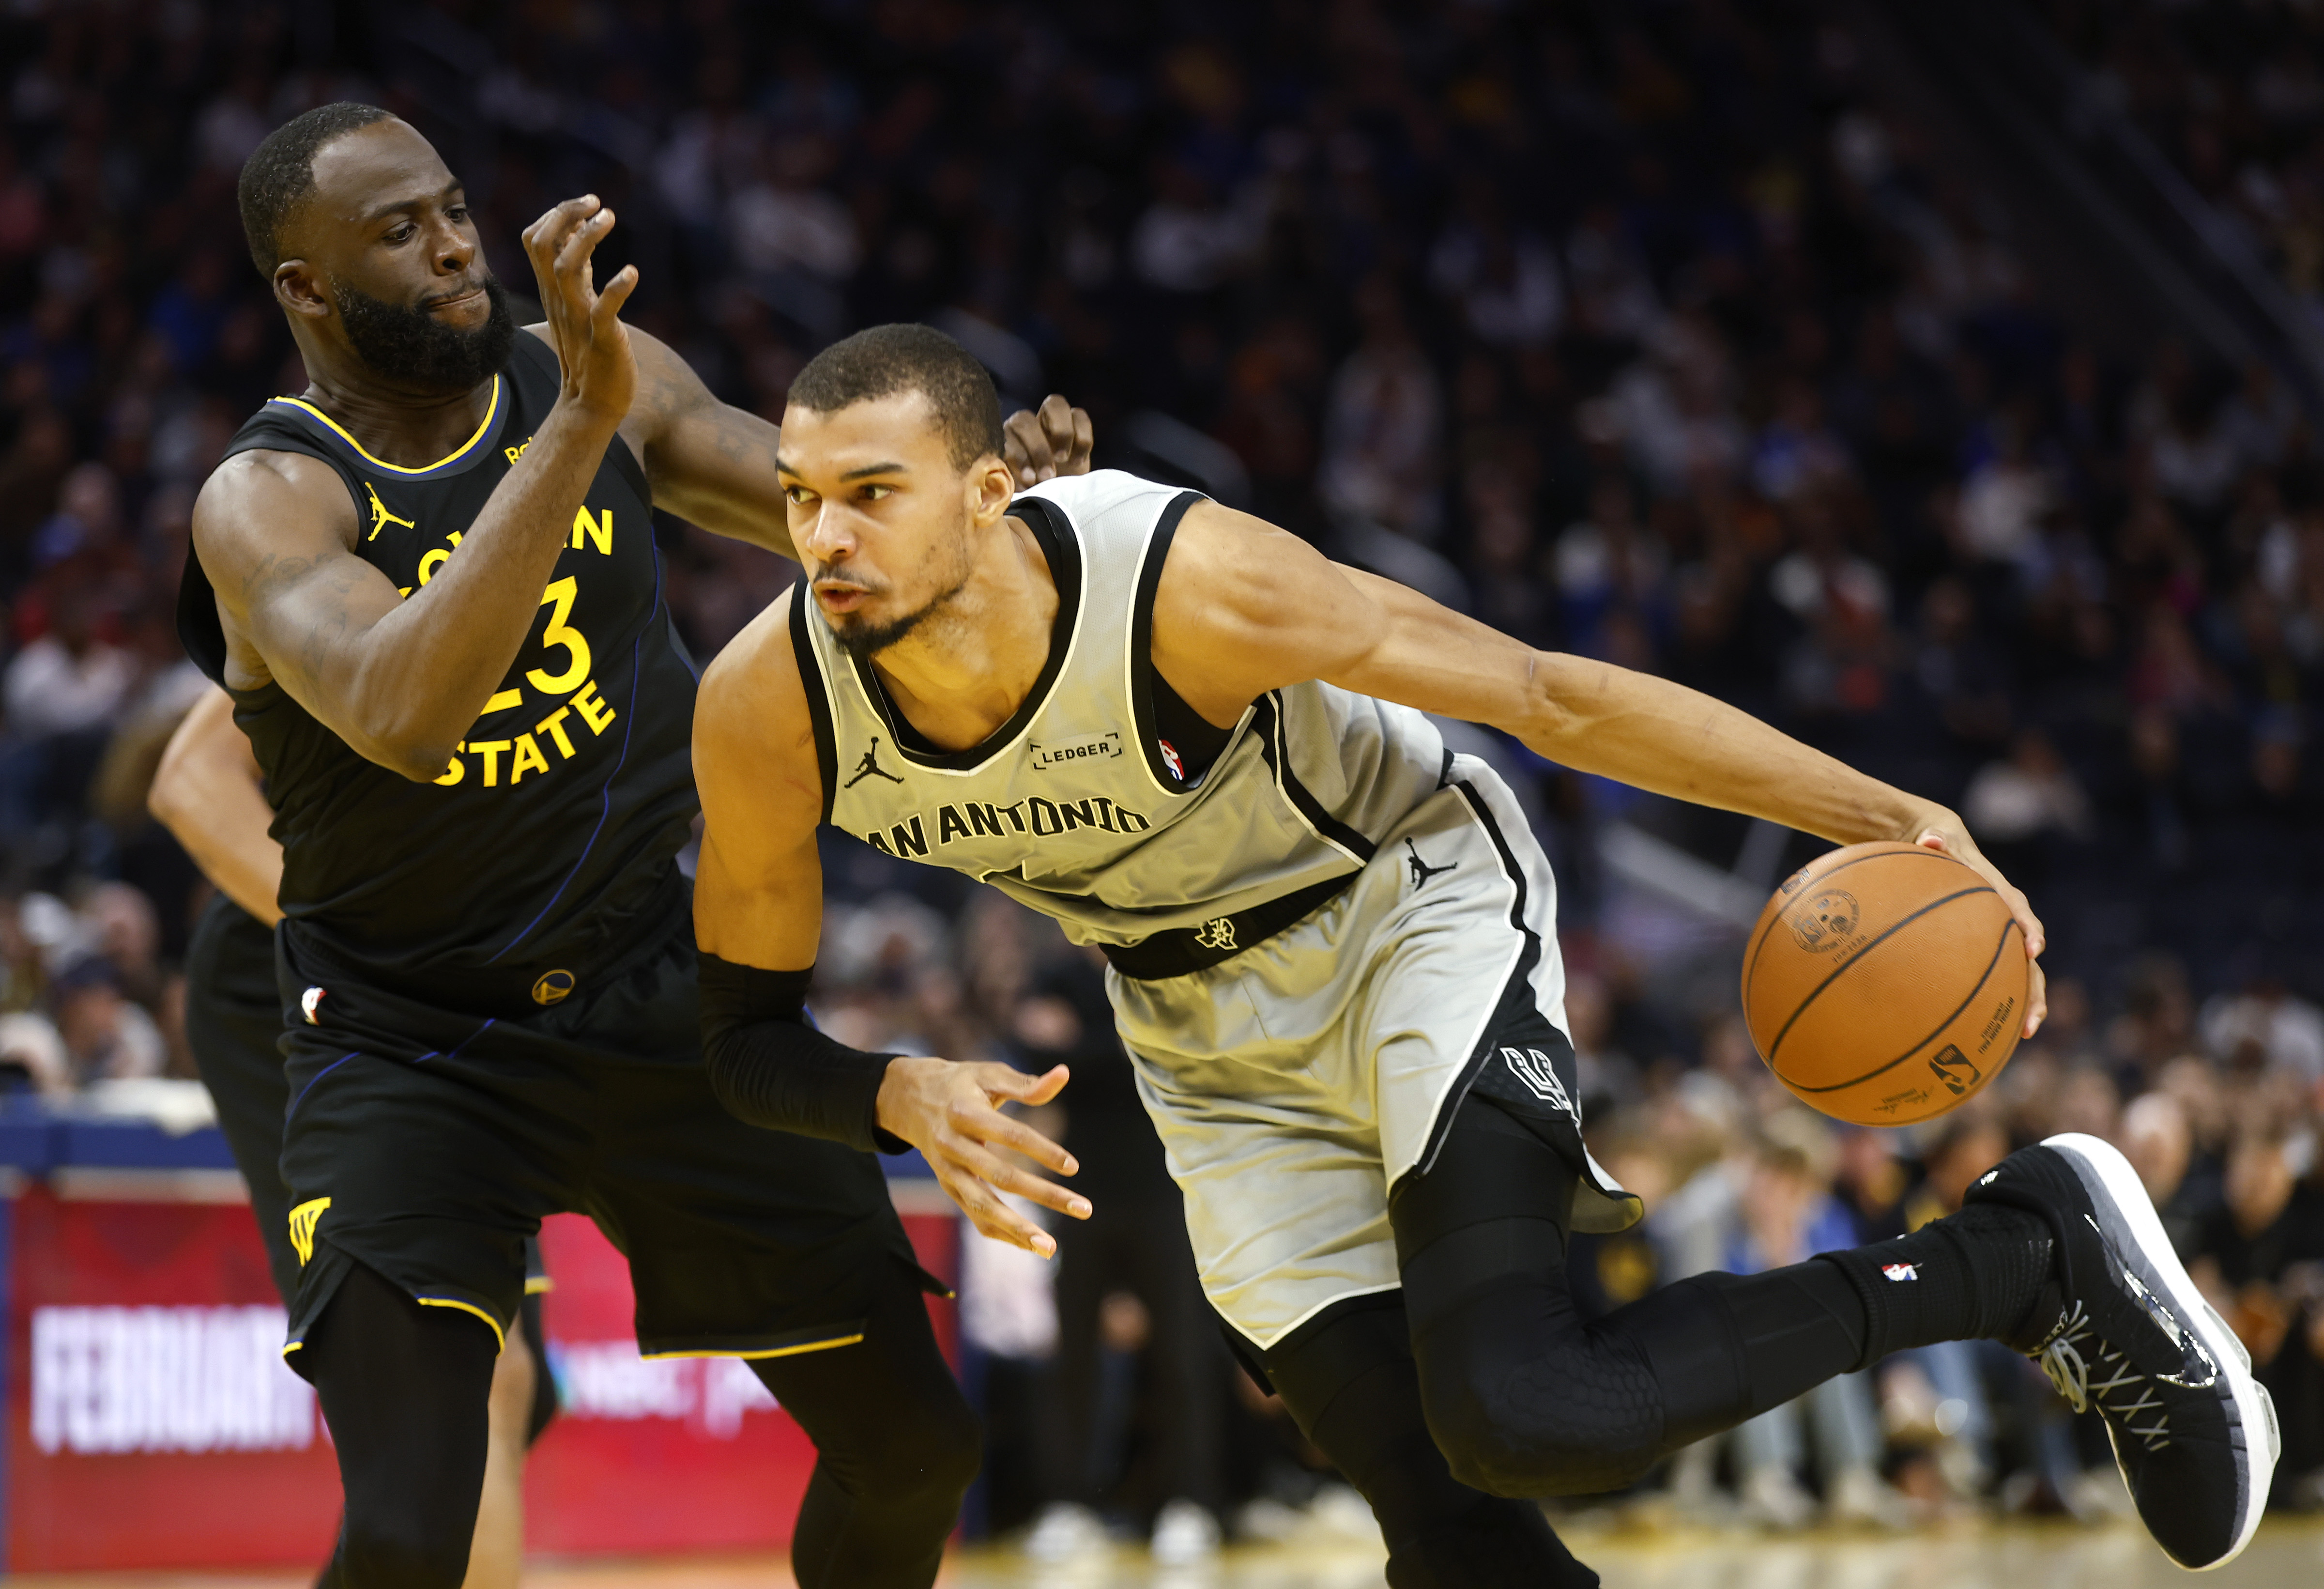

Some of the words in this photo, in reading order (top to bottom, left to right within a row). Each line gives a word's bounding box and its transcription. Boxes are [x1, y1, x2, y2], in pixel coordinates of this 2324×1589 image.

[479, 575, 592, 716] 3
[432, 679, 617, 787] STATE
[1042, 742, 1109, 763] LEDGER
[866, 812, 931, 859] AN
[937, 796, 1152, 846] ANTONIO
